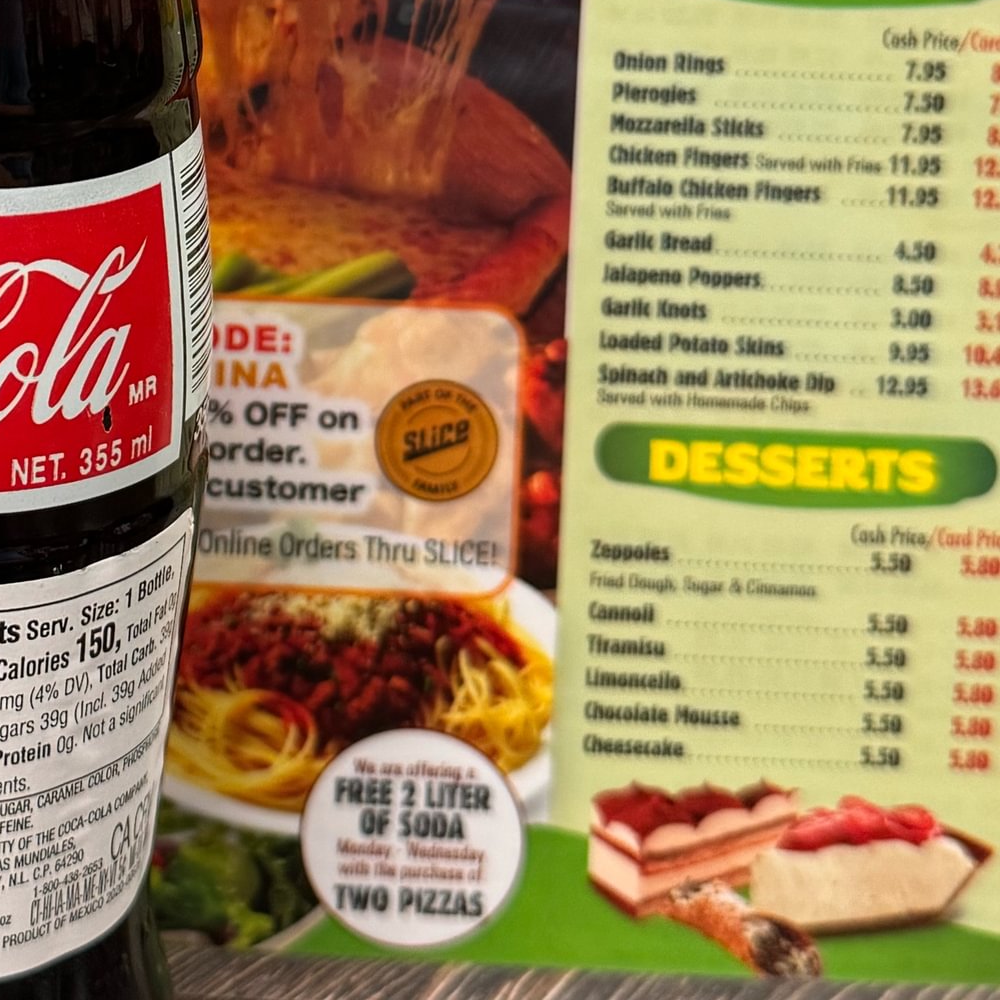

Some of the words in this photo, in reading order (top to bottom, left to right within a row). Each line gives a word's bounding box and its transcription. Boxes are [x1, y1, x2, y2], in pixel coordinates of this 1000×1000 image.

[613, 51, 667, 72] Onion
[673, 53, 725, 76] Rings
[904, 61, 948, 82] 7.95
[610, 114, 706, 135] Mozzarella
[711, 117, 765, 138] Sticks
[607, 176, 673, 197] Buffalo
[679, 178, 749, 199] Chicken
[755, 180, 821, 203] Fingers
[128, 375, 157, 407] MR
[244, 400, 308, 428] OFF
[318, 409, 359, 430] on
[10, 450, 67, 487] NET.
[79, 438, 123, 473] 355
[130, 426, 154, 454] ml
[208, 440, 307, 465] order.
[648, 439, 938, 494] DESSERTS
[206, 478, 365, 502] customer
[199, 529, 272, 557] Online
[279, 531, 356, 561] Orders
[363, 535, 416, 564] Thru
[424, 538, 498, 568] SLICE!
[26, 617, 74, 640] Serv.
[81, 598, 120, 626] Size:
[125, 587, 133, 608] 1
[137, 565, 175, 601] Bottle,
[588, 601, 655, 623] Cannoli
[76, 621, 121, 662] 150,
[127, 611, 152, 642] Total
[154, 598, 167, 621] Fat
[30, 681, 59, 710] (4%
[64, 671, 93, 697] DV),
[97, 653, 128, 683] Total
[131, 637, 157, 666] Carb.
[40, 708, 68, 731] 39g
[74, 692, 107, 725] (Incl.
[112, 679, 135, 703] 39g
[137, 648, 167, 688] Added
[584, 700, 669, 723] Chocolate
[674, 703, 741, 726] Mousse
[56, 735, 78, 754] 0g.
[82, 720, 105, 744] Not
[108, 717, 116, 732] a
[583, 734, 684, 757] Cheesecake
[37, 781, 85, 809] CARAMEL
[88, 763, 120, 789] COLOR,
[335, 777, 393, 805] FREE
[401, 780, 416, 806] 2
[425, 781, 491, 810] LITER
[18, 835, 33, 851] OF
[36, 827, 55, 846] THE
[58, 803, 112, 838] COCA-COLA
[360, 808, 390, 835] OF
[399, 811, 464, 839] SODA
[335, 884, 389, 912] TWO
[399, 886, 483, 916] PIZZAS
